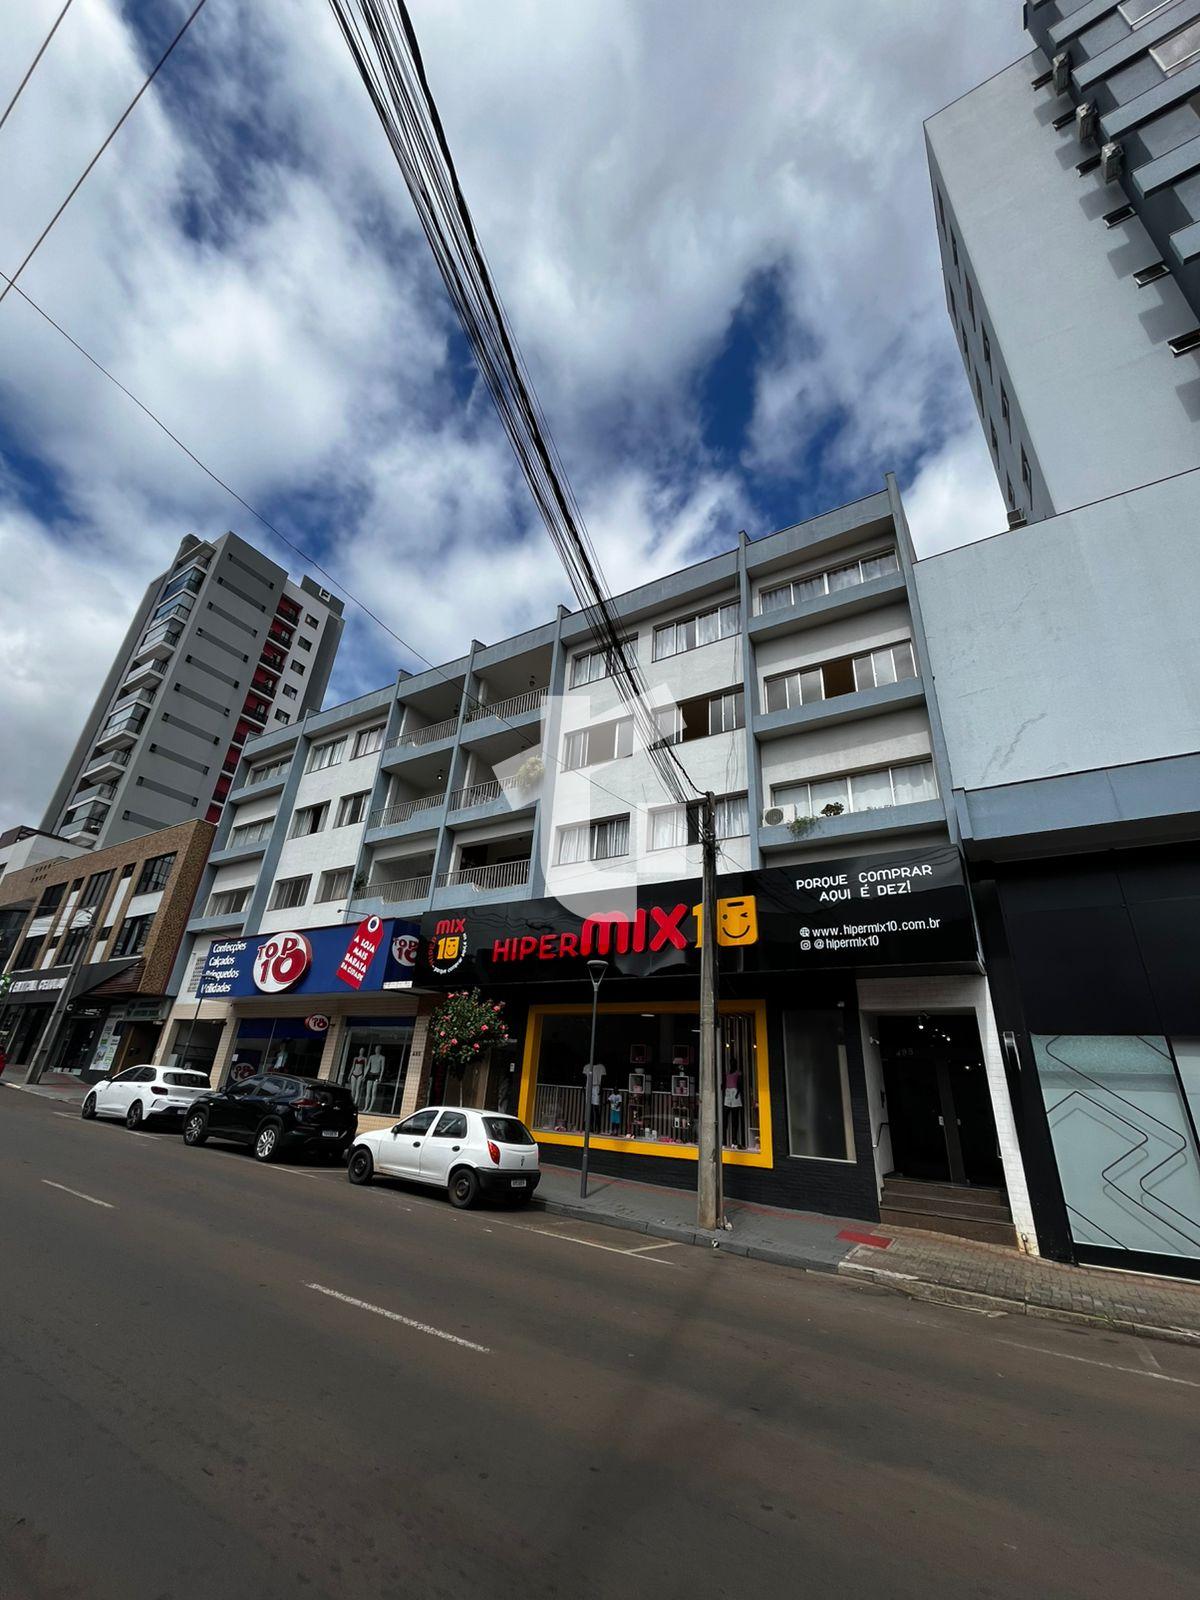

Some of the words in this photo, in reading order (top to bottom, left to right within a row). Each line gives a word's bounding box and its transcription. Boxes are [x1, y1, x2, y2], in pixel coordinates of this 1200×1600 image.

[796, 874, 848, 890] PORQUE
[858, 864, 933, 883] COMPRAR
[819, 888, 851, 902] AQUI
[860, 883, 870, 898] É
[877, 880, 912, 896] DEZ!
[435, 918, 466, 935] MIX
[812, 917, 941, 937] www.hipermix10.com.br
[212, 941, 247, 953] Confecções
[257, 937, 299, 960] TOP
[354, 935, 360, 943] A
[360, 938, 375, 953] LOJA
[393, 937, 419, 950] TOP
[814, 935, 880, 950] @hipermix10
[209, 955, 235, 968] Calçados
[353, 946, 368, 961] MAIS
[260, 948, 306, 983] 10
[344, 952, 366, 973] BARATA
[347, 967, 364, 982] CIDADE
